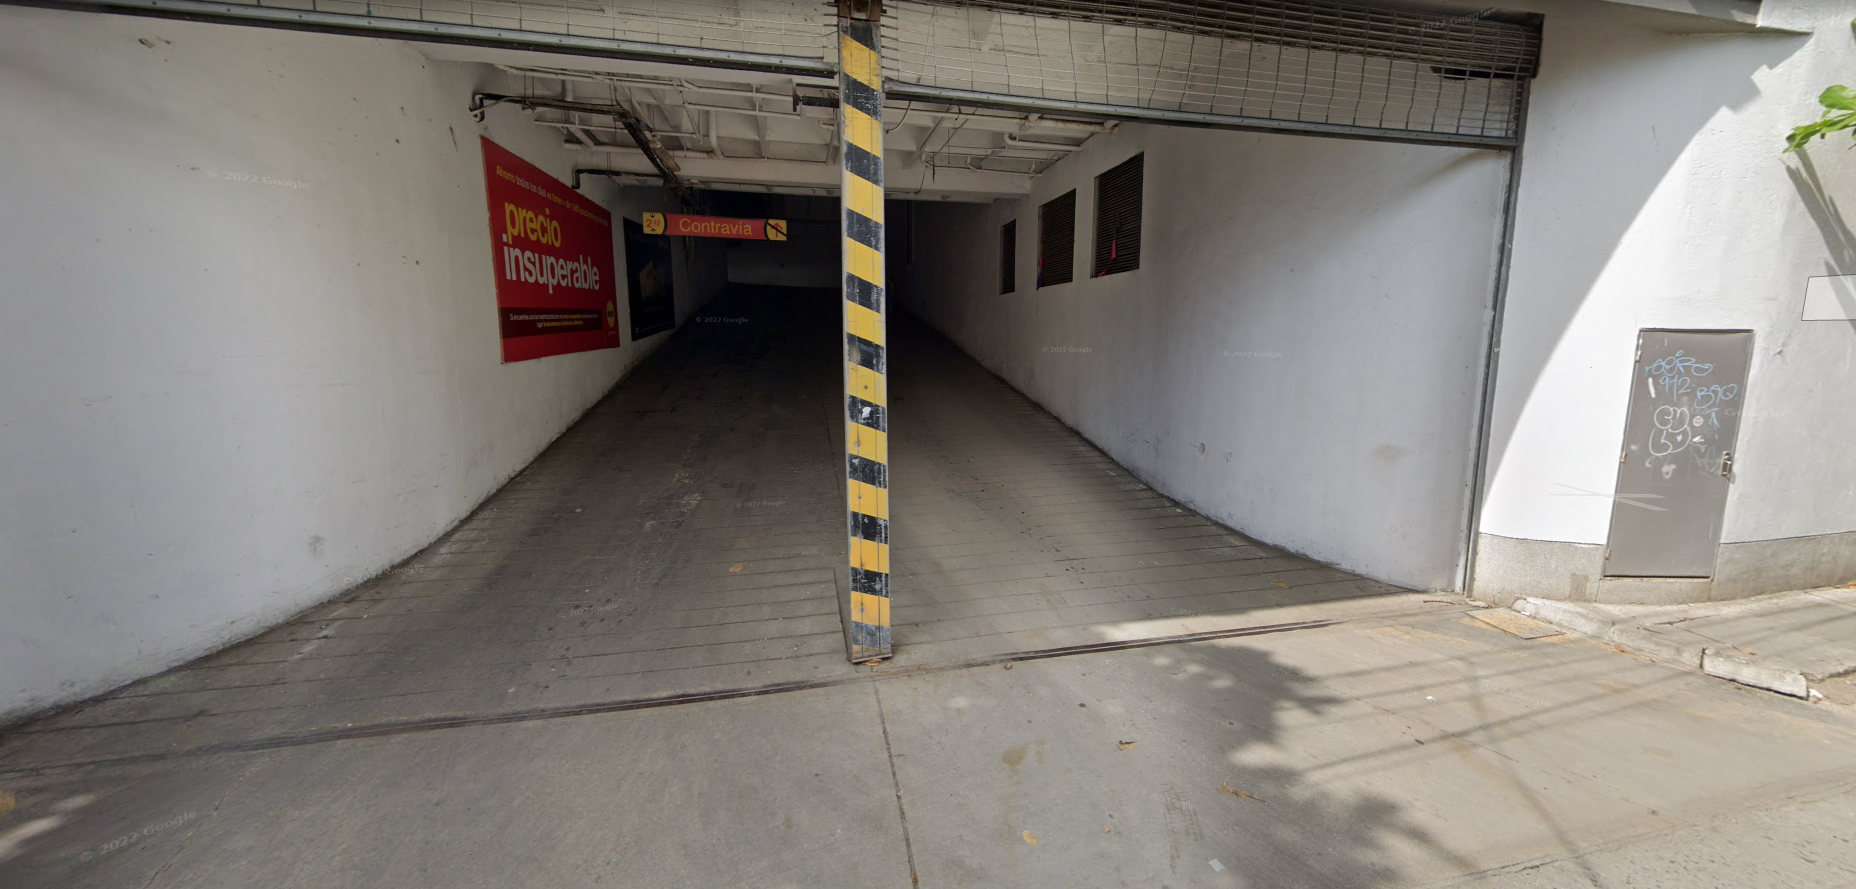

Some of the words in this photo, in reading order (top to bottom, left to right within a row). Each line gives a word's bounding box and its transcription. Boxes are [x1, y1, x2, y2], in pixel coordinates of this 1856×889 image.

[496, 165, 516, 183] Ahorro
[515, 174, 530, 190] todos
[529, 181, 538, 193] los
[504, 202, 562, 248] precio
[679, 218, 753, 235] Contravía
[502, 233, 600, 295] insuperable
